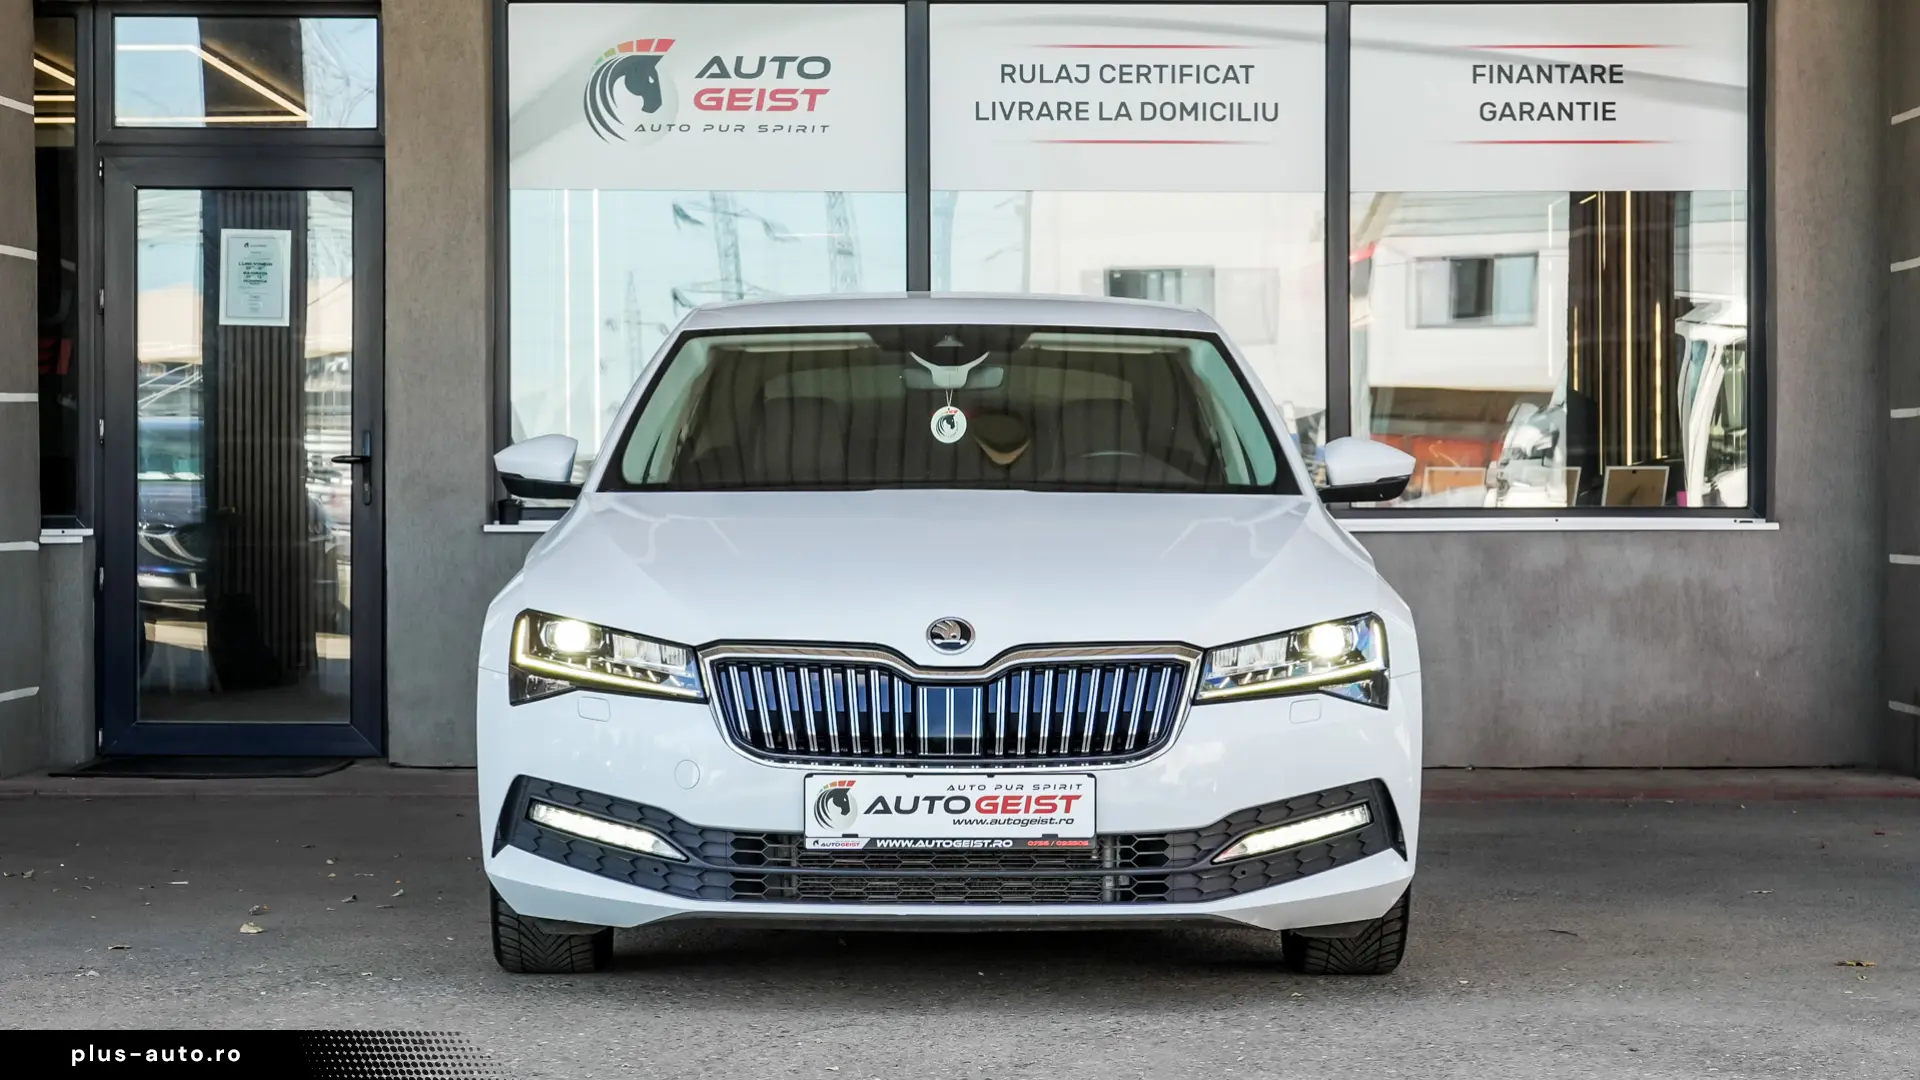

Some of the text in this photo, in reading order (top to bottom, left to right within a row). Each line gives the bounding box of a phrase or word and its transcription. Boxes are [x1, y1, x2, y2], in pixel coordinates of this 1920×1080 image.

[694, 55, 832, 80] AUTO
[1000, 63, 1255, 85] RULAJ CERTIFICAT
[1472, 64, 1624, 84] FINANTARE
[693, 87, 831, 112] GEIST
[975, 101, 1279, 122] LIVRARE LA DOMICILIU
[1479, 101, 1617, 122] GARANTIE
[634, 123, 830, 134] AUTO PUR SPIRIT
[946, 783, 1083, 791] AUTO PUR SPIRIT
[863, 794, 1083, 815] AUTOGEIST
[952, 816, 1075, 828] www.autogeist.ro
[876, 838, 1013, 848] WWW.AUTOGEIST.RO
